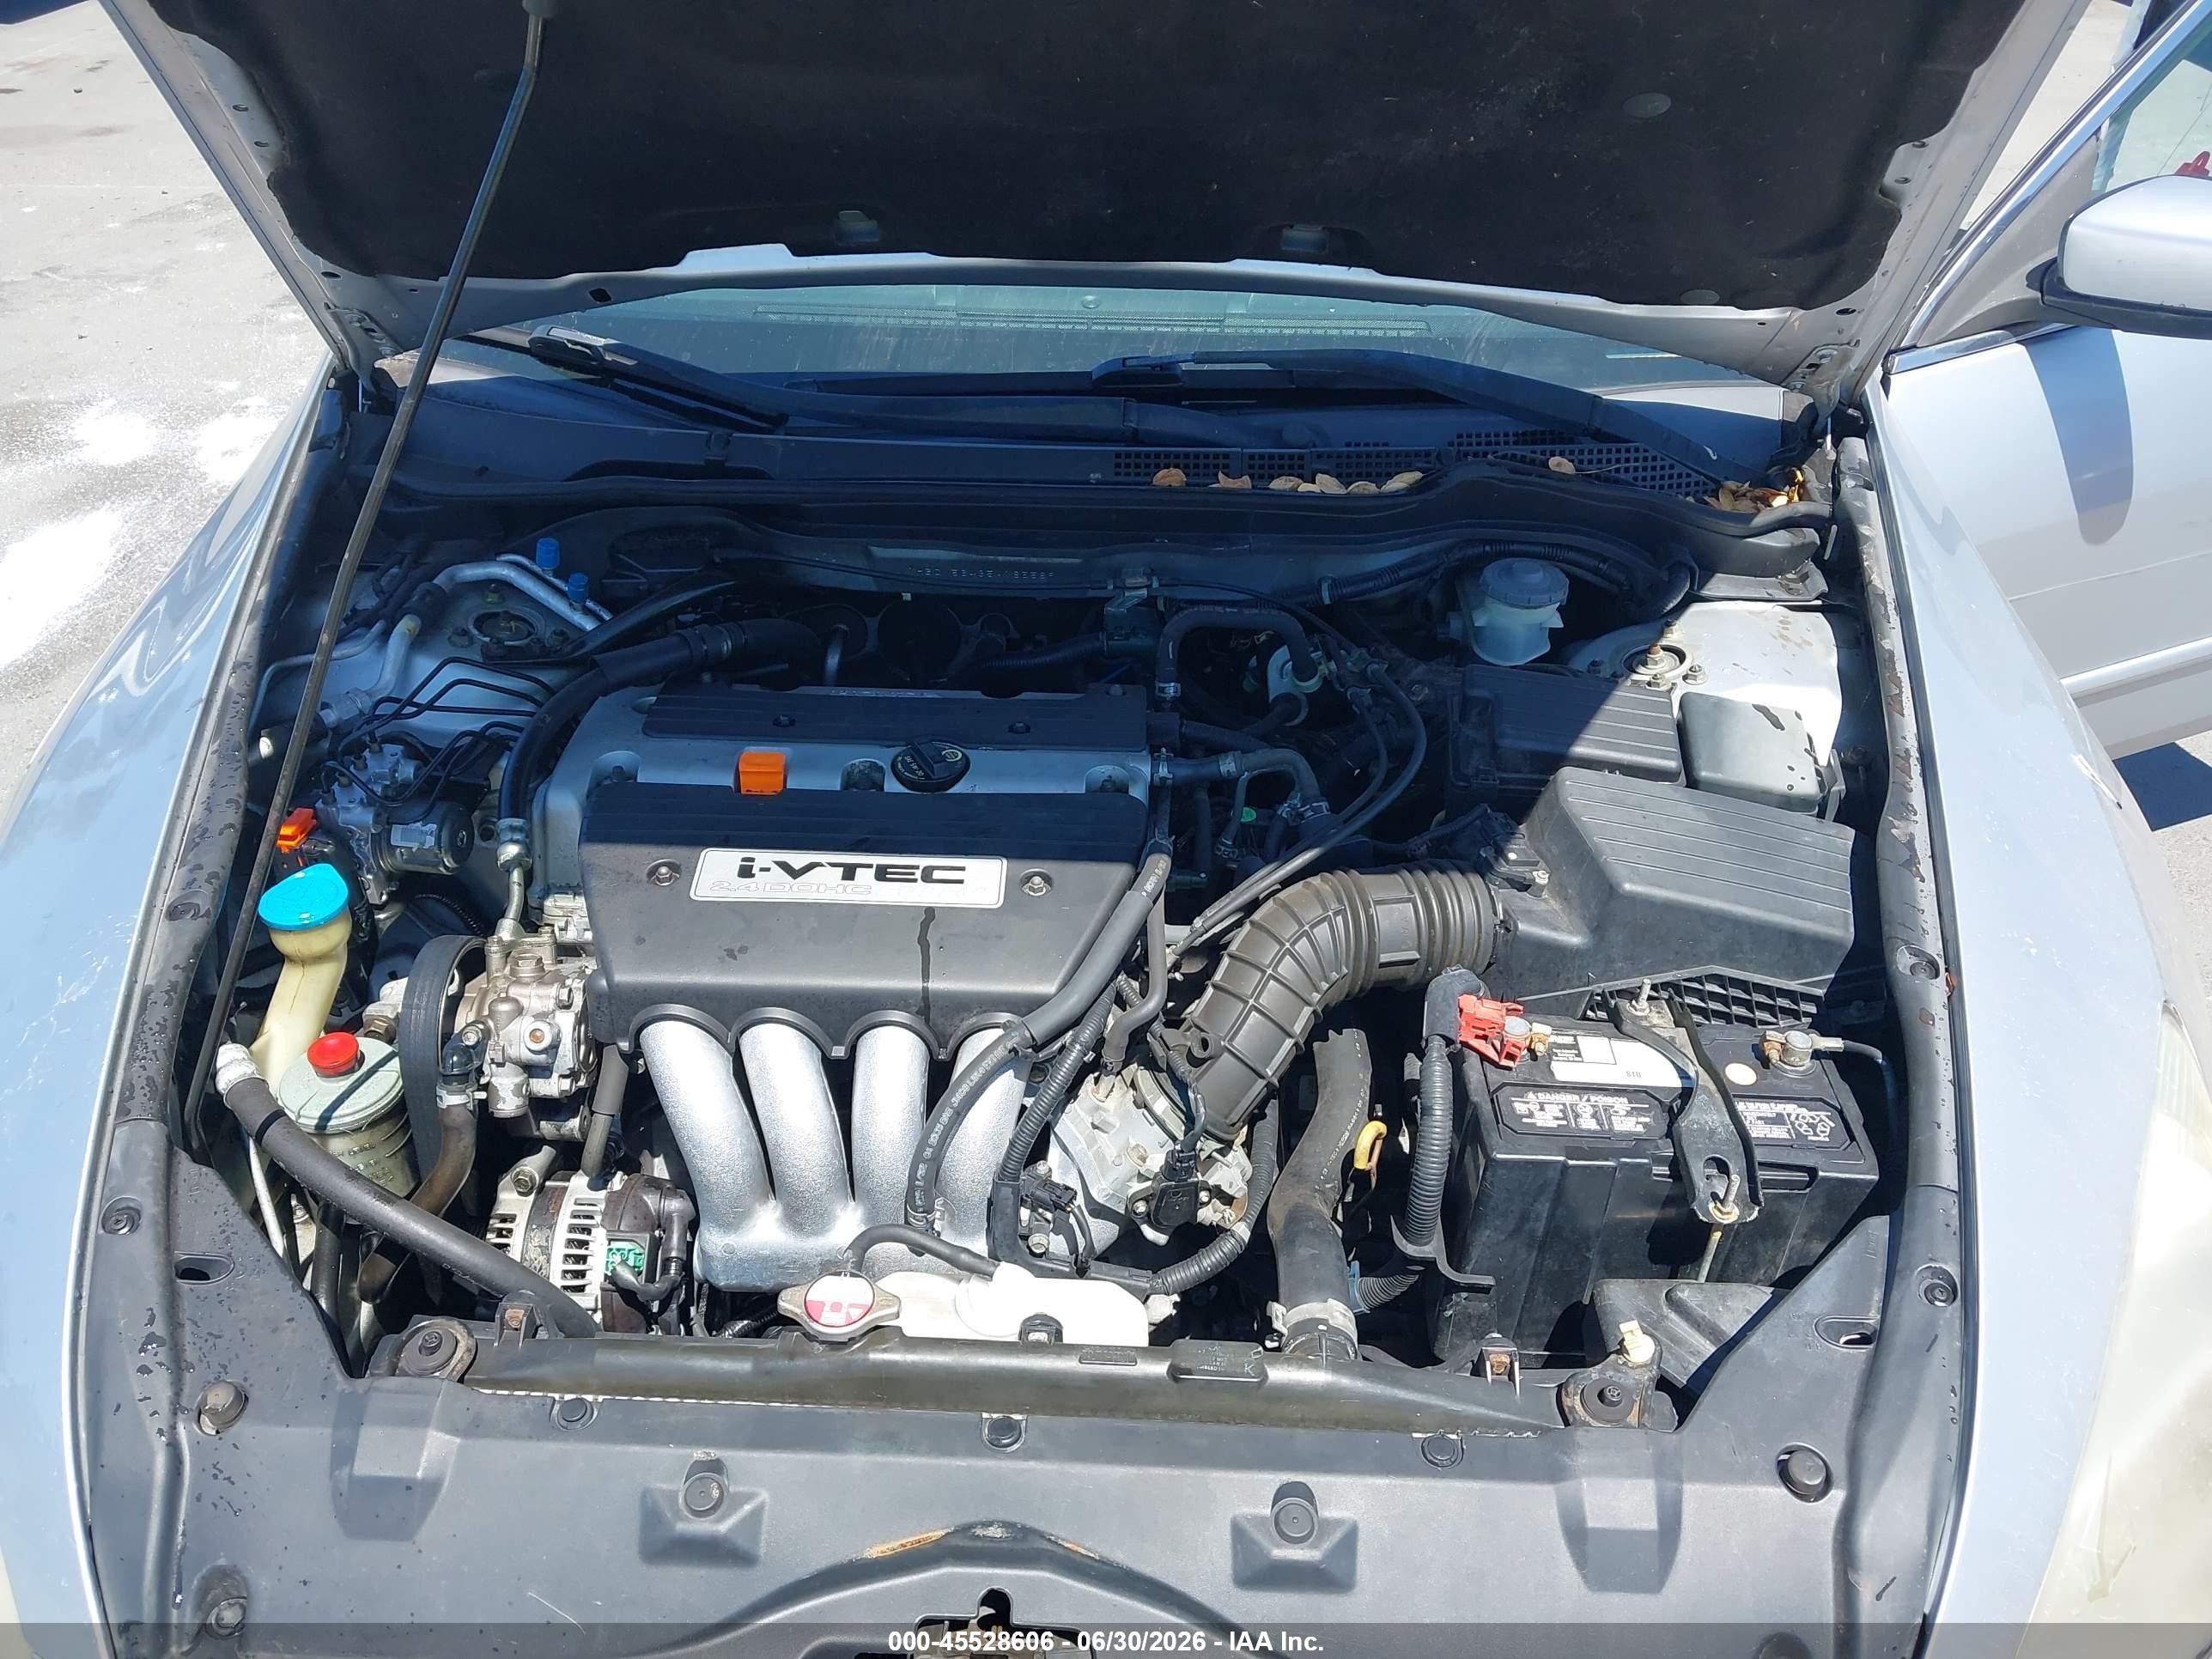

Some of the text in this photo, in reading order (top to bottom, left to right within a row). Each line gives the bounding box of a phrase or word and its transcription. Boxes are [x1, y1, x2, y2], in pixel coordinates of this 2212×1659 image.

[737, 856, 966, 884] i-VTEC
[763, 882, 872, 896] DOHC
[1538, 1092, 1580, 1103] DANGER
[1590, 1094, 1629, 1104] POISON
